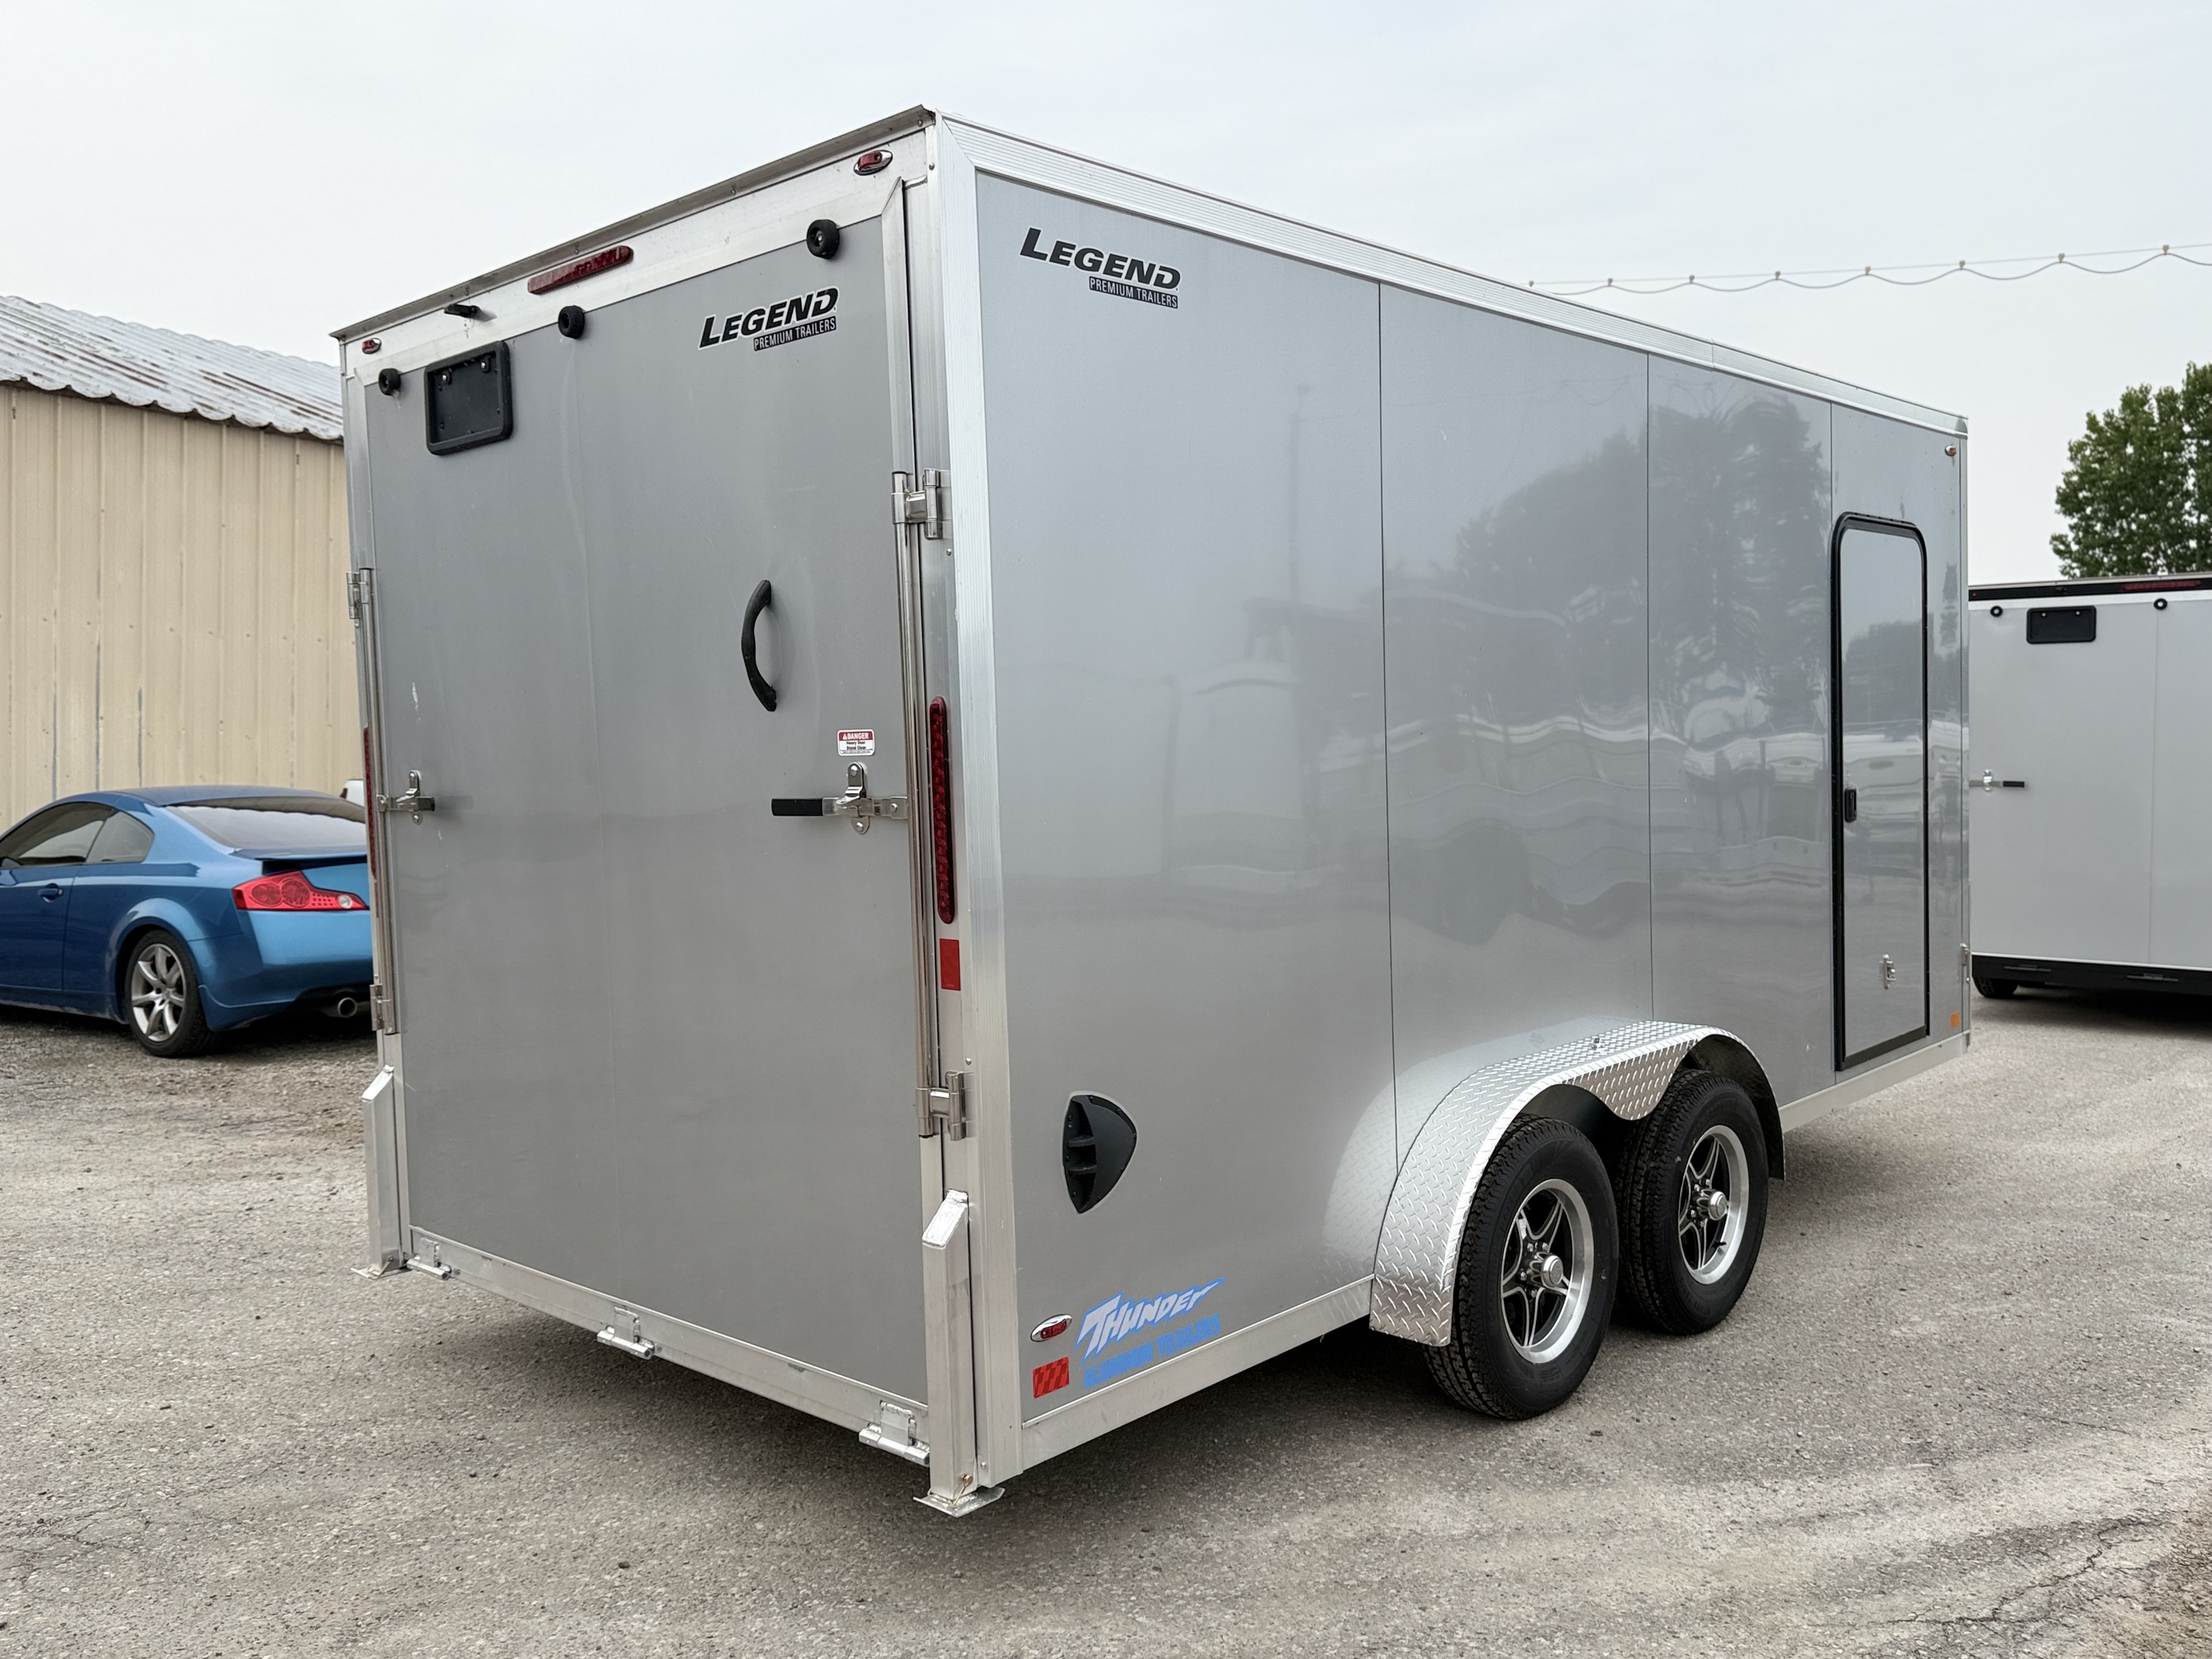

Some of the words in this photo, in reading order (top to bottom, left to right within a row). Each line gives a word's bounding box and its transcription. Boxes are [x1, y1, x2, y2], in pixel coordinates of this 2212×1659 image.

[1019, 227, 1181, 289] LEGEND
[698, 287, 838, 348] LEGEND
[1090, 278, 1134, 298] PREMIUM
[1136, 287, 1177, 308] TRAILERS
[754, 331, 793, 350] PREMIUM
[796, 318, 836, 339] TRAILERS
[1074, 1279, 1224, 1364] THUNDER
